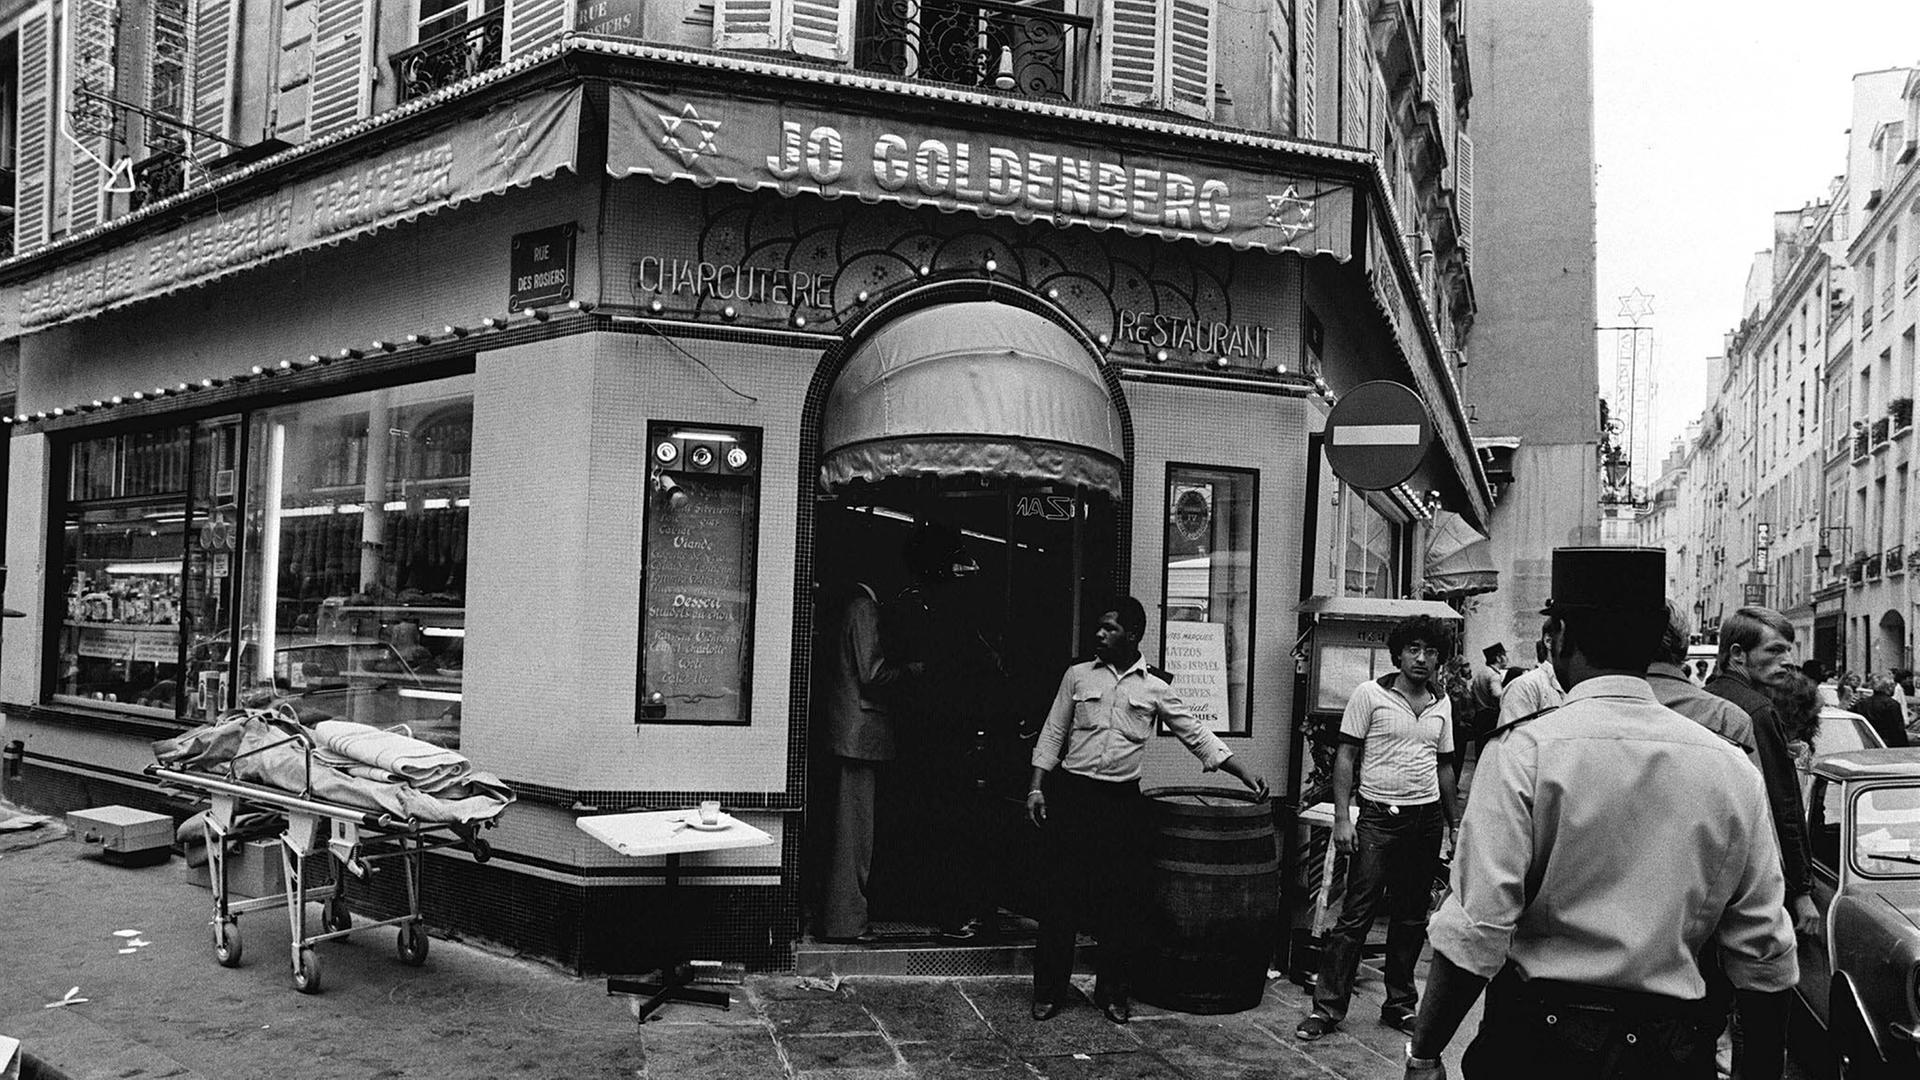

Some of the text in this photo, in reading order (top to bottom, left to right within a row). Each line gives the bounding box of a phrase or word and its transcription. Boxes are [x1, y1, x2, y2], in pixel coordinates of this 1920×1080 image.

[312, 143, 453, 236] TRAITEUR
[766, 120, 1231, 234] JO GOLDENBERG
[534, 244, 550, 262] RUE
[518, 268, 565, 292] DES ROSIERS
[640, 255, 833, 308] CHARCUTERIE
[1119, 309, 1274, 359] RESTAURANT
